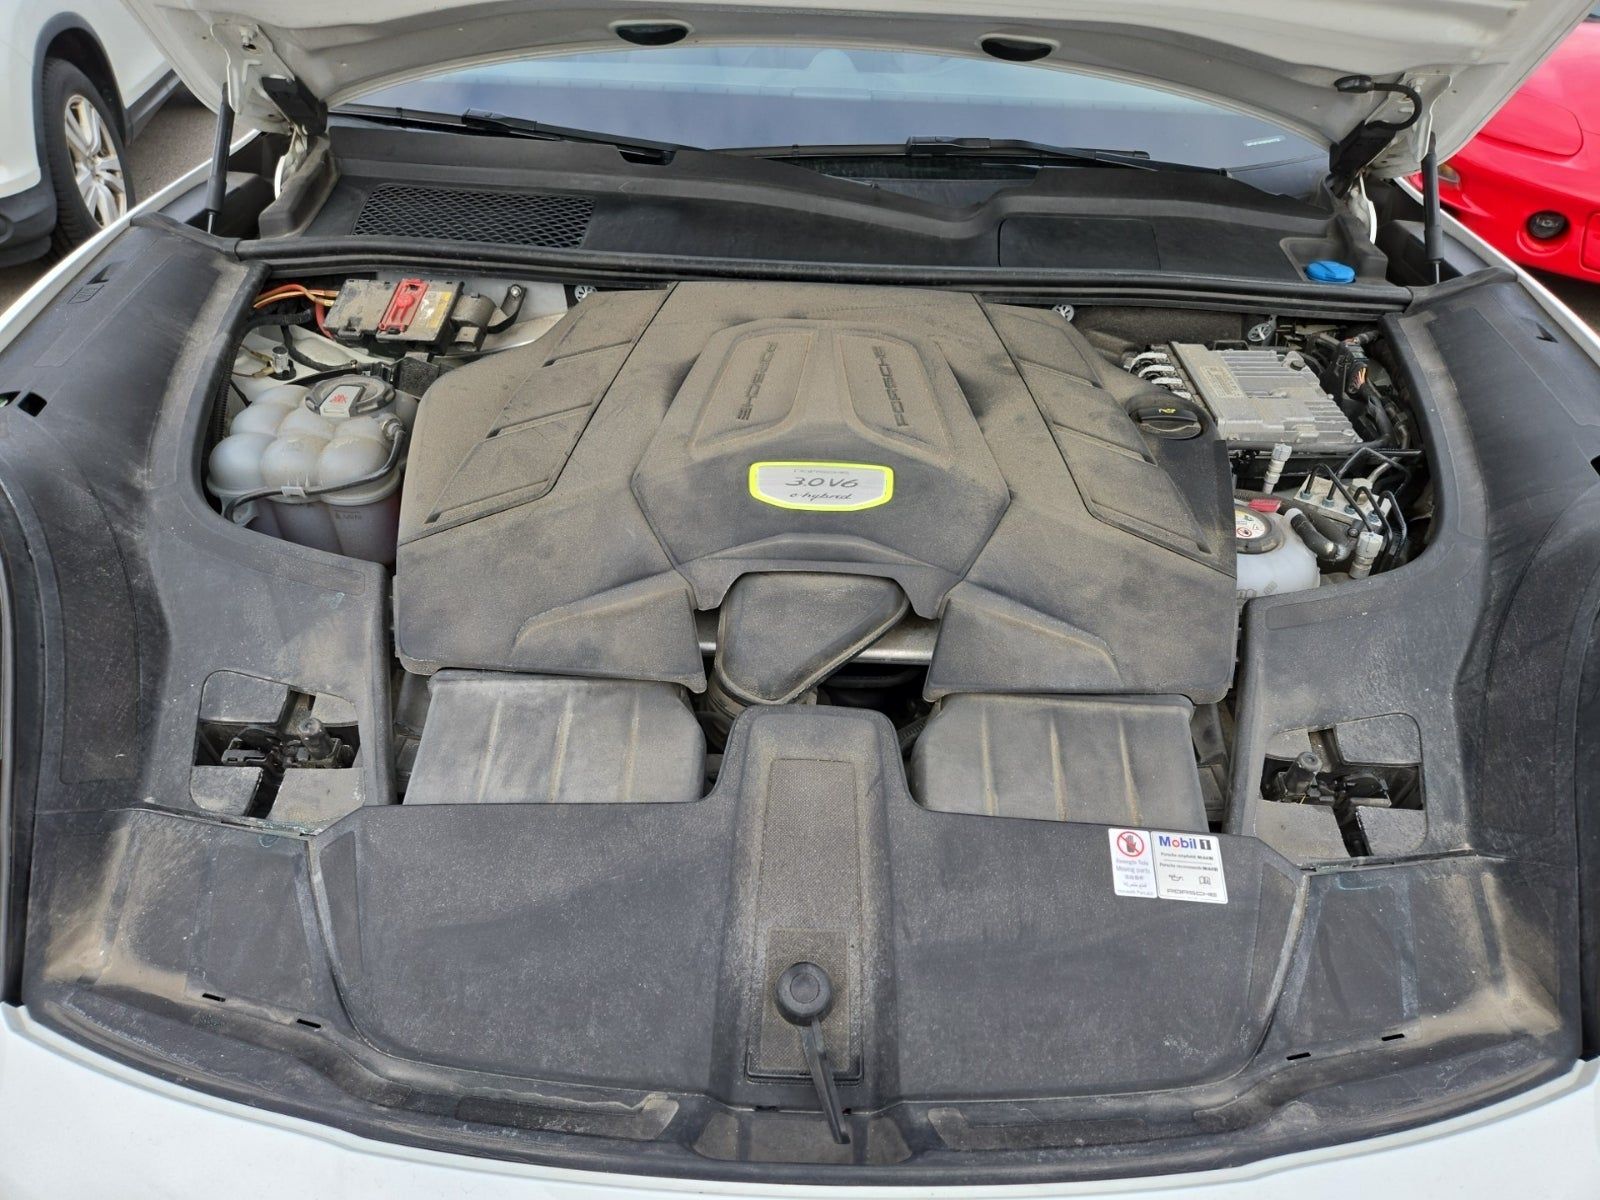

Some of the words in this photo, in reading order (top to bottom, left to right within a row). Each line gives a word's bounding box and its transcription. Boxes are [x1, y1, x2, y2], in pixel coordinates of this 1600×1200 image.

[737, 341, 778, 421] PORSCHE
[872, 346, 909, 427] PORSCHE
[829, 478, 859, 488] V6
[1158, 835, 1197, 850] Mobil
[1167, 888, 1217, 897] PORSCHE
